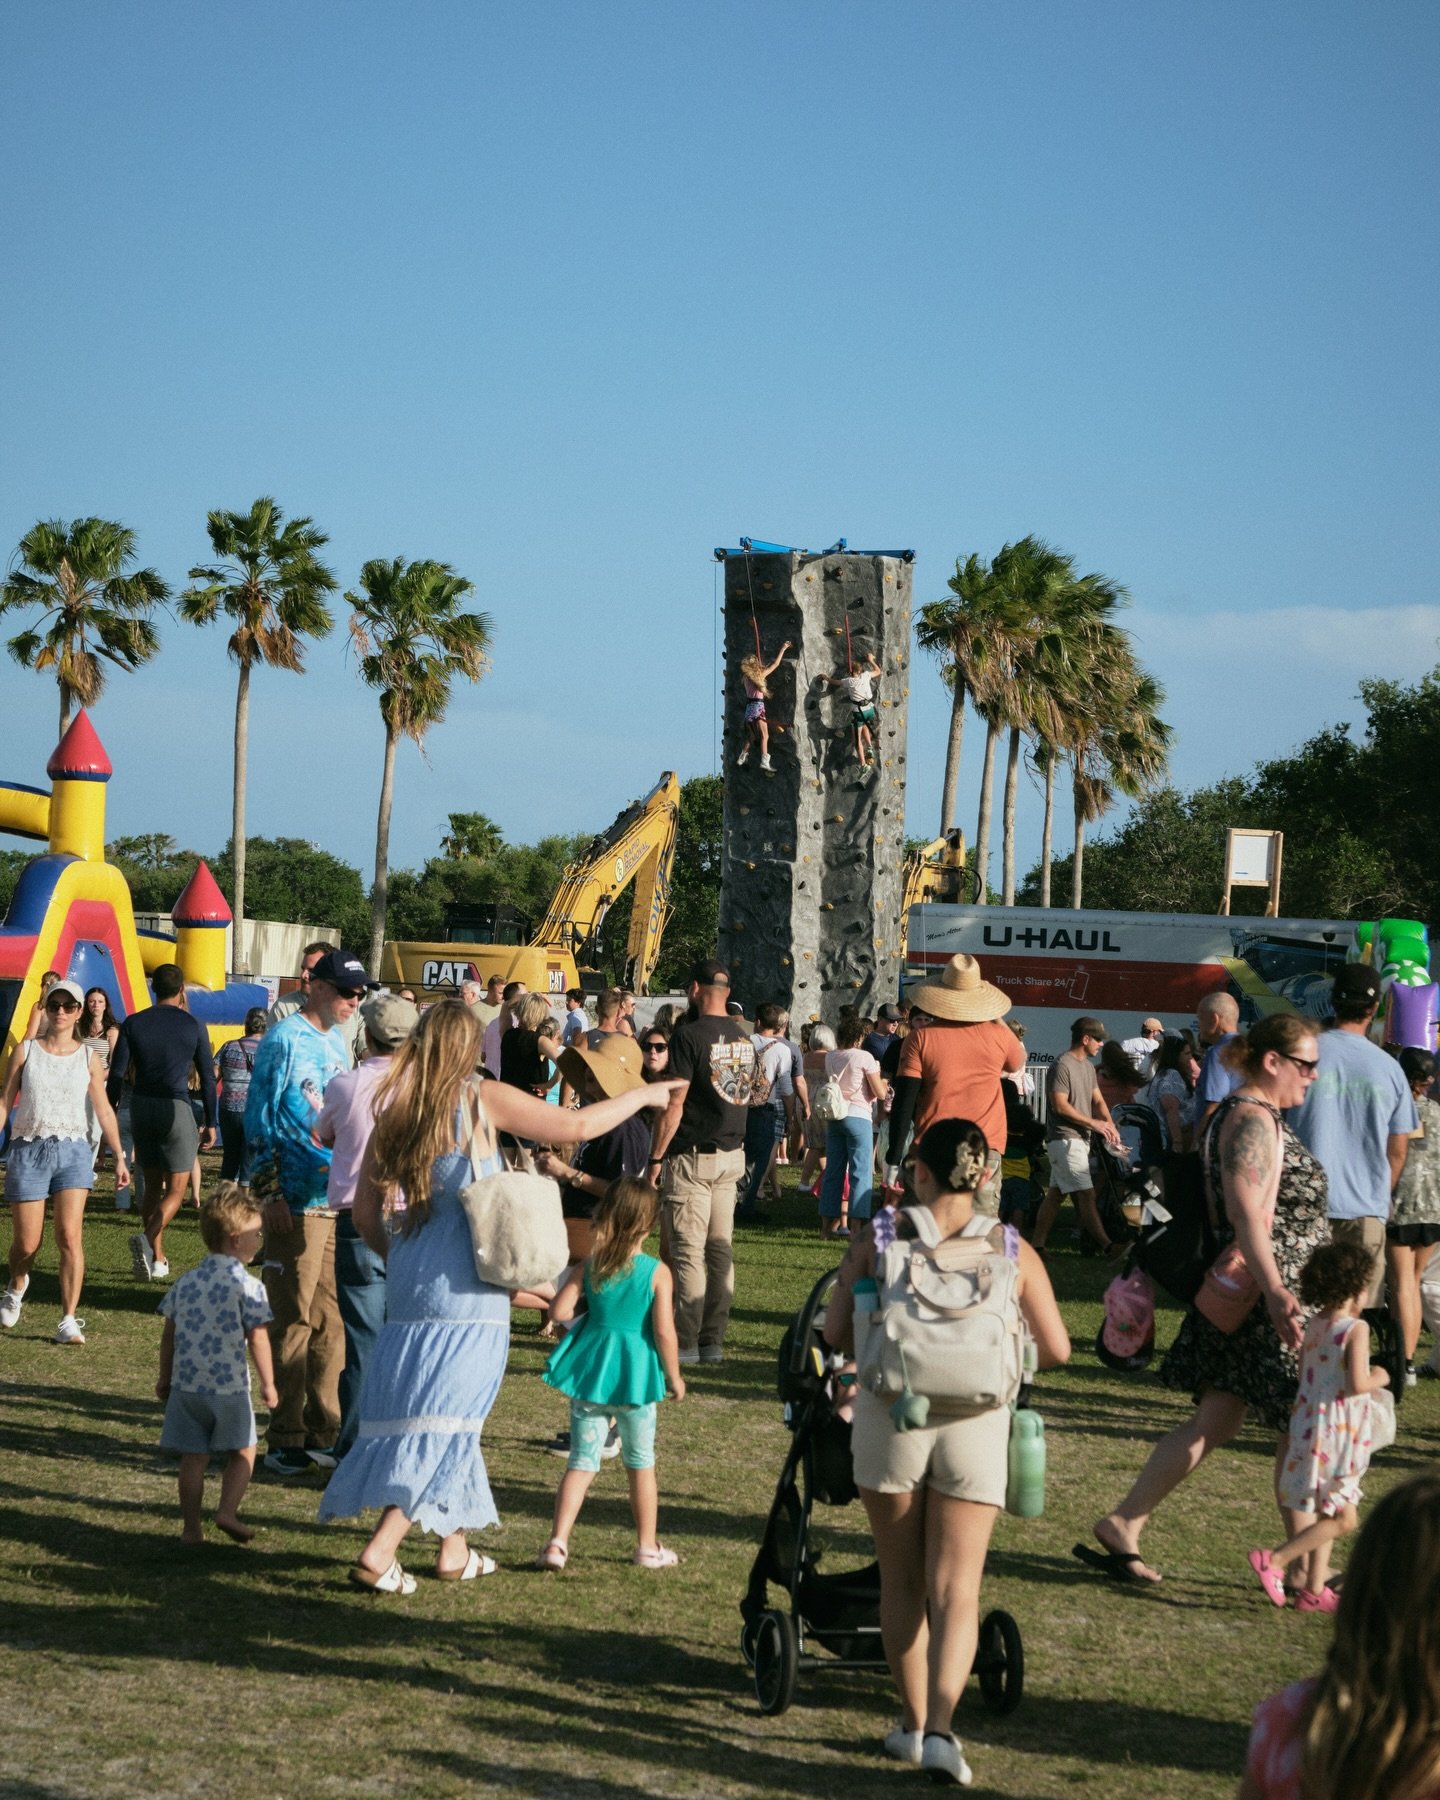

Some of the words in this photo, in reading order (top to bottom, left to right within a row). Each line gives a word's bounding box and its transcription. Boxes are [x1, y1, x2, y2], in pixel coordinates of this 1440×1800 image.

[423, 960, 469, 990] CAT
[548, 970, 564, 993] CAT
[996, 975, 1022, 985] Truck
[1024, 976, 1052, 986] Share
[1054, 977, 1075, 989] 24/7
[1028, 1052, 1055, 1063] Ride
